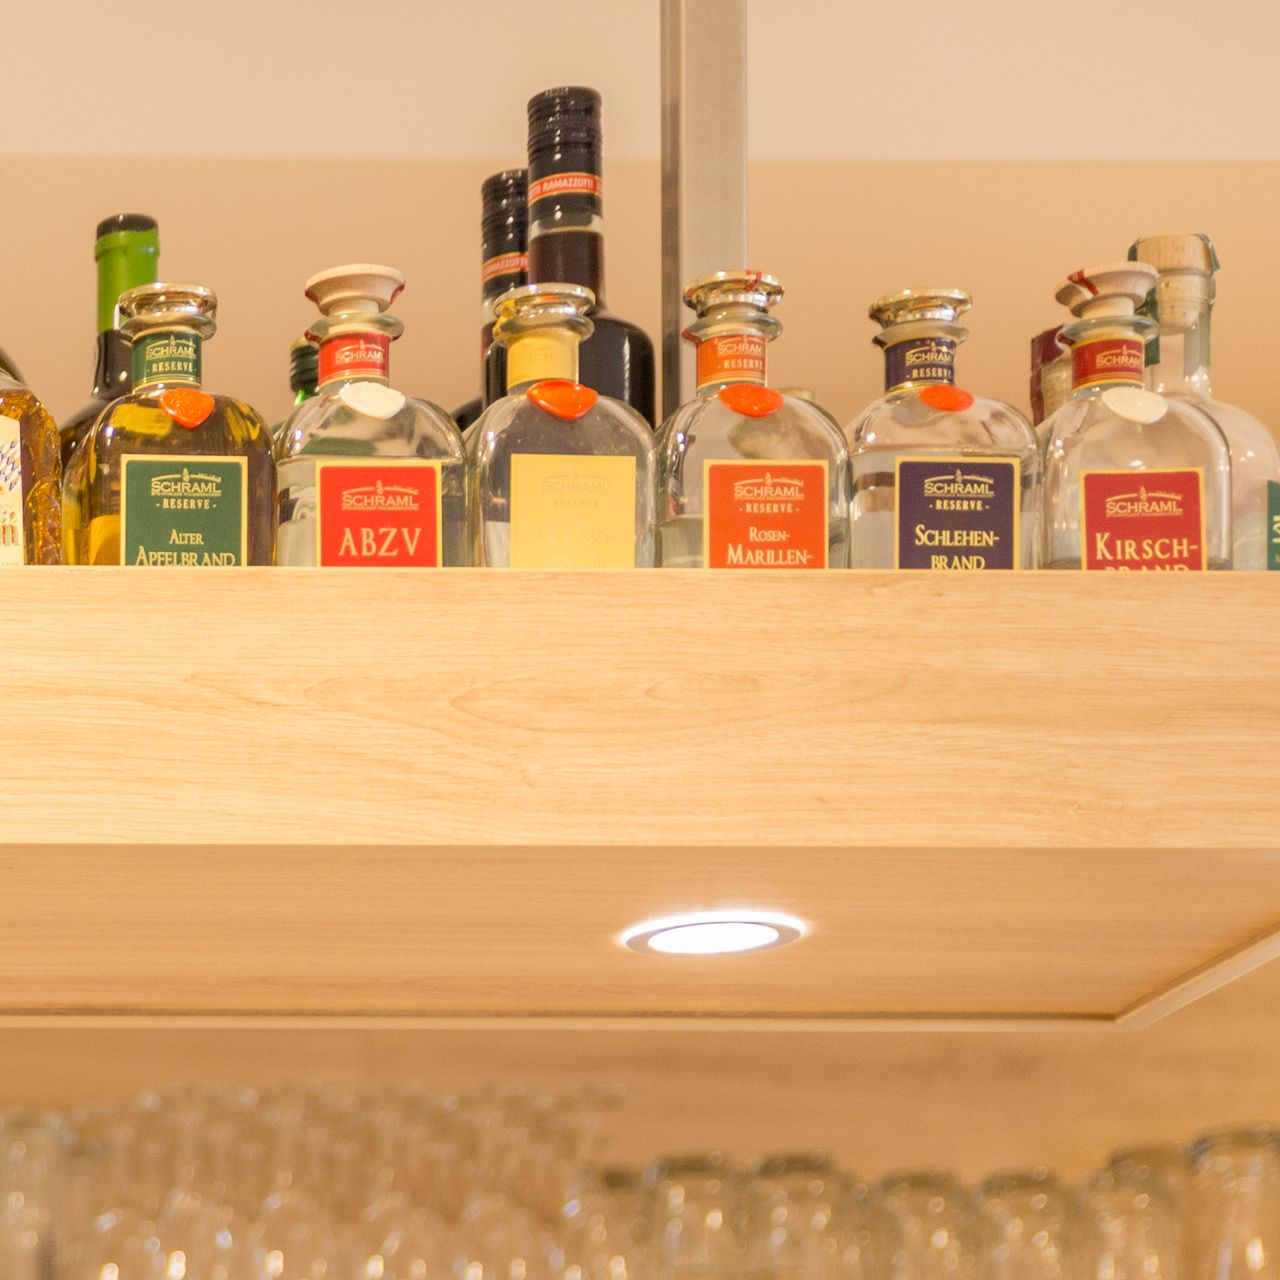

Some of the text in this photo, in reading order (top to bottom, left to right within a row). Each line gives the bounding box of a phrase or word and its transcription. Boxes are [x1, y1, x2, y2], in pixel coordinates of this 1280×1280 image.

[543, 177, 594, 192] RAMAZZOTTI
[152, 361, 194, 372] RESERVE
[151, 481, 222, 494] SCHRAML
[733, 486, 804, 498] SCHRAML
[924, 483, 995, 495] SCHRAML
[162, 499, 211, 509] RESERVE
[342, 494, 419, 507] SCHRAML
[935, 500, 983, 511] RESERVE
[1106, 501, 1183, 514] SCHRAML
[745, 503, 794, 514] RESERVE
[169, 529, 204, 545] ALTER
[749, 526, 790, 542] ROSEN-
[915, 524, 1000, 547] SCHLEHEN-
[338, 528, 422, 556] ABZV
[1095, 532, 1198, 561] KIRSCH-
[134, 546, 236, 566] APFELBRAND
[726, 543, 814, 566] MARILLEN-
[930, 555, 986, 570] BRAND
